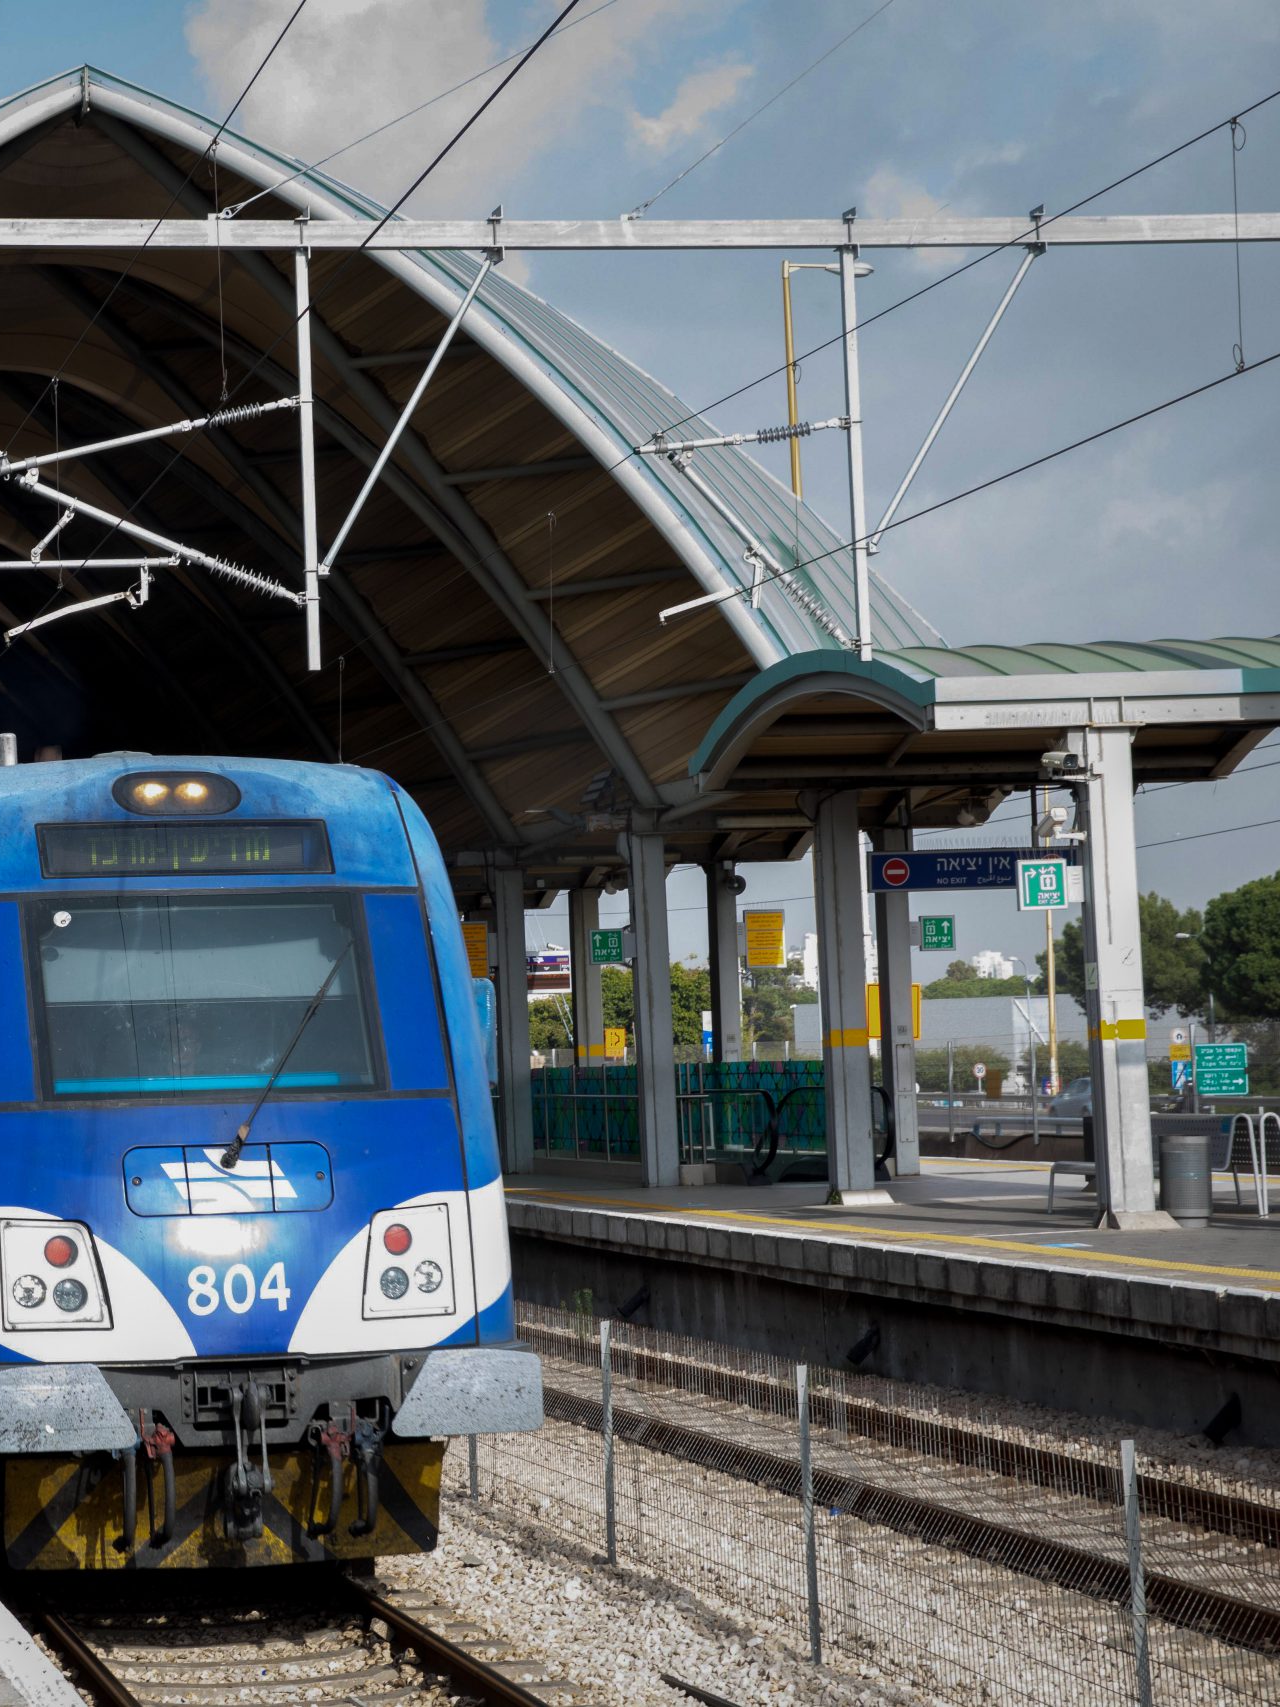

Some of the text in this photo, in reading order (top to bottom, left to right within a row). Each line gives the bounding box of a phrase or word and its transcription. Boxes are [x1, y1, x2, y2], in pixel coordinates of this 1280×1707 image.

[936, 856, 1011, 874] אין יציאה
[1037, 892, 1060, 900] יציאה
[925, 935, 951, 943] יציאה
[594, 948, 620, 956] יציאה
[186, 1262, 291, 1316] 804
